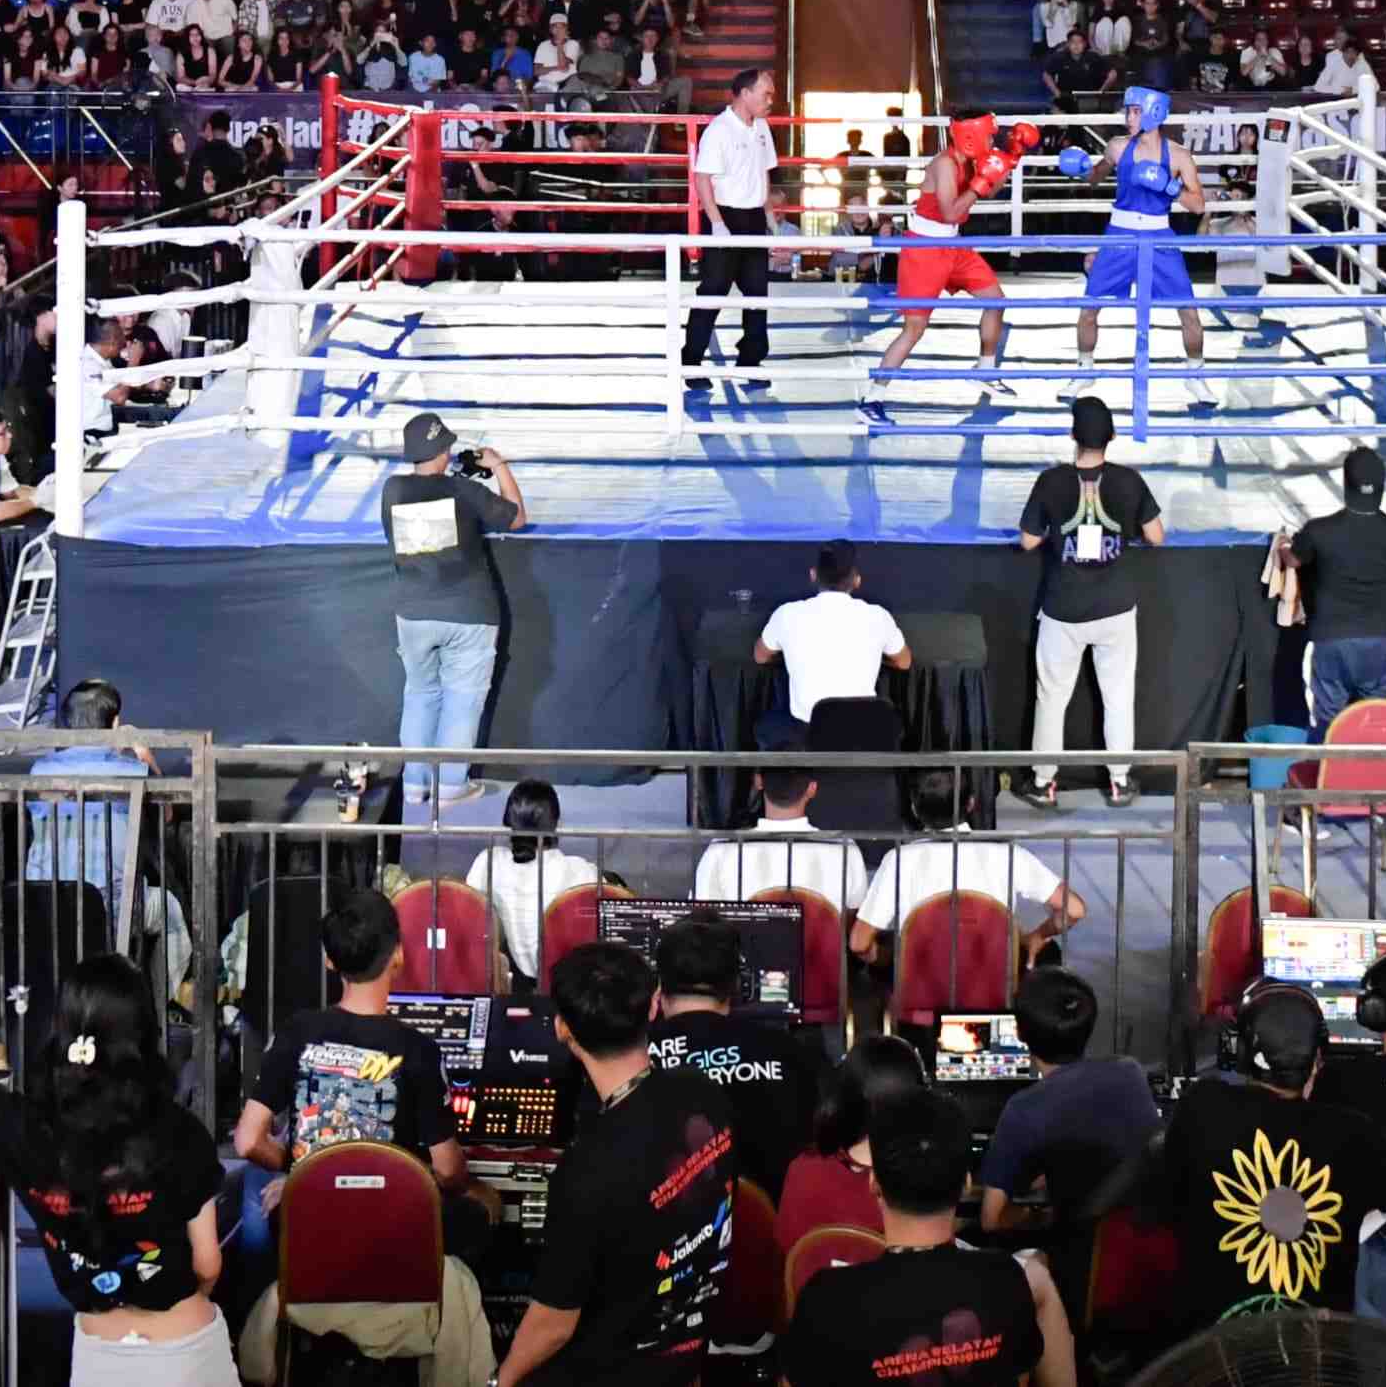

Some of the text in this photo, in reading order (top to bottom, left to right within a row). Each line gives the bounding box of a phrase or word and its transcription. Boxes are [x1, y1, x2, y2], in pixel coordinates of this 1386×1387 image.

[1062, 534, 1121, 563] ARI
[686, 1046, 740, 1068] GIGS
[703, 1061, 783, 1085] RYONE
